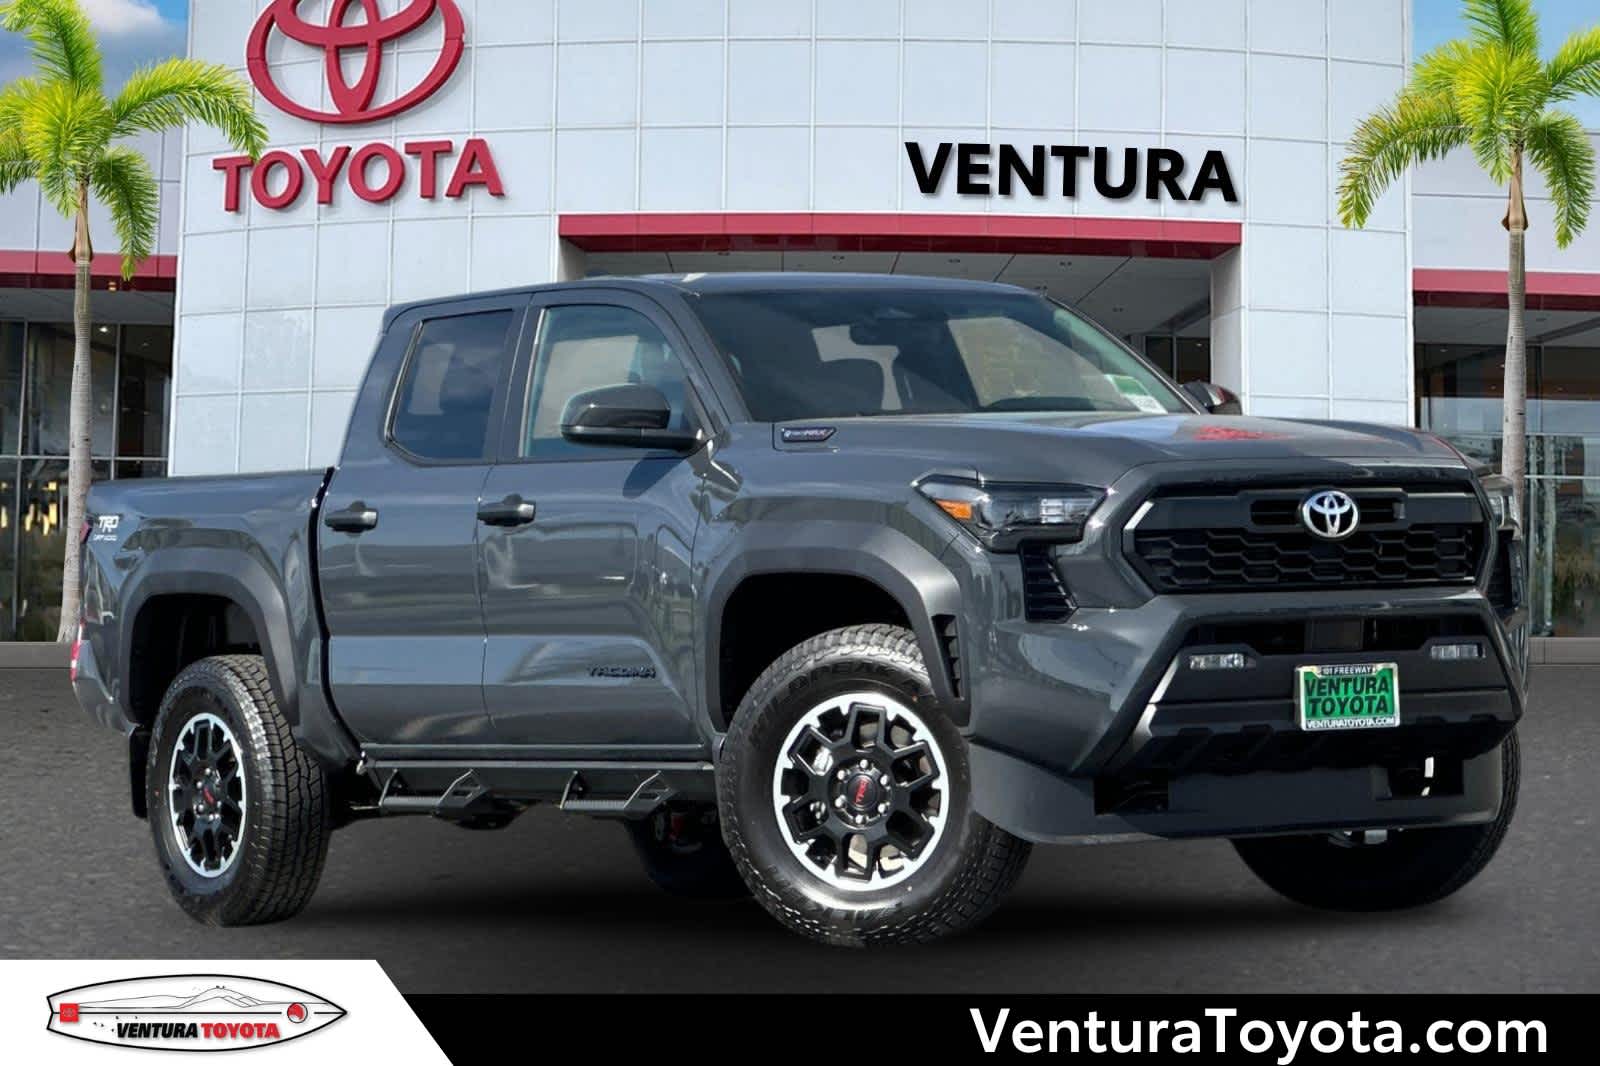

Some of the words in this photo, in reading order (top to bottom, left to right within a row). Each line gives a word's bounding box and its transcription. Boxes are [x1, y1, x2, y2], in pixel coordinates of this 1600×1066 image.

[212, 138, 505, 212] TOYOTA
[904, 141, 1238, 202] VENTURA
[1334, 665, 1372, 675] FREEWAY
[1304, 676, 1390, 696] VENTURA
[1308, 696, 1389, 716] TOYOTA
[1306, 717, 1395, 729] VENTURATOYOTA.COM
